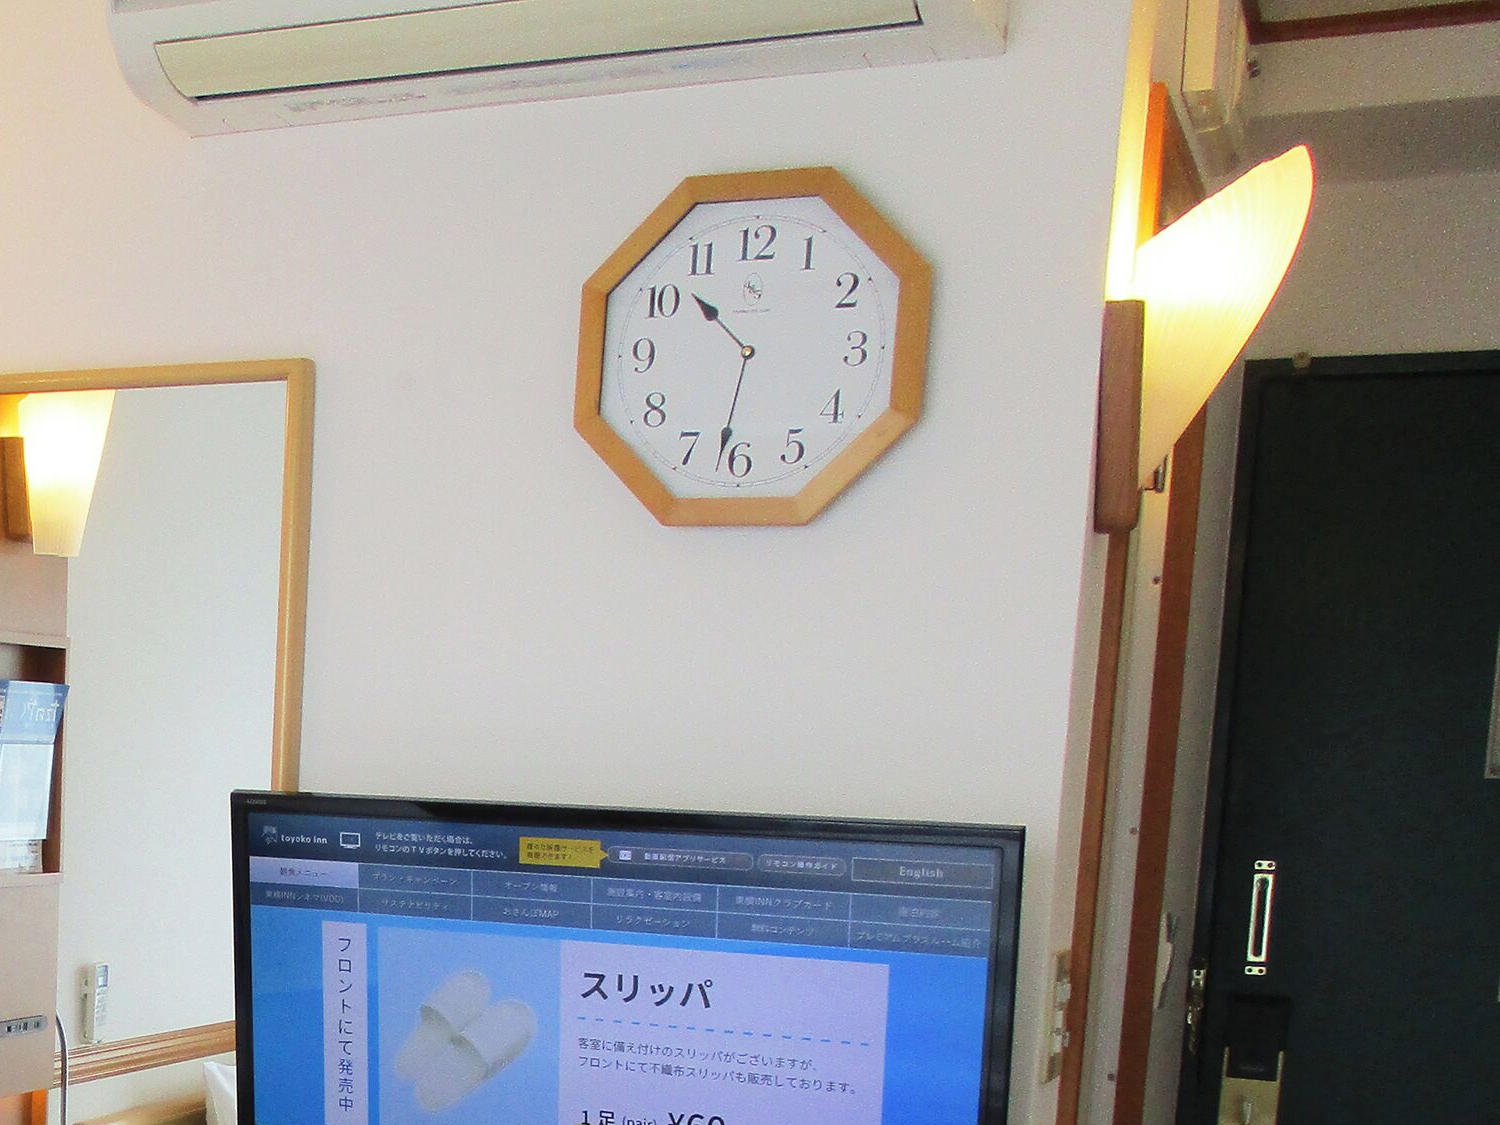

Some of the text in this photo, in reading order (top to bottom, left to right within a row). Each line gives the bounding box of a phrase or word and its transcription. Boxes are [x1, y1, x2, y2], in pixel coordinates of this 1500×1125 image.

[687, 241, 716, 276] 11
[736, 225, 778, 262] 12
[800, 236, 816, 271] 1
[645, 283, 681, 319] 10
[834, 272, 861, 310] 2
[631, 337, 656, 374] 9
[843, 330, 869, 367] 3
[642, 392, 667, 428] 8
[820, 389, 845, 425] 4
[679, 431, 701, 466] 7
[727, 442, 753, 479] 6
[780, 428, 806, 465] 5
[280, 833, 329, 846] toyoko inn
[898, 865, 943, 880] English
[581, 971, 713, 1009] スリッパ
[338, 937, 353, 1113] フロントにて発売中
[578, 1036, 818, 1072] 客室に備え付けのスリッパがございますが、
[579, 1056, 857, 1095] フロントにて不織布スリッパも販売しております。
